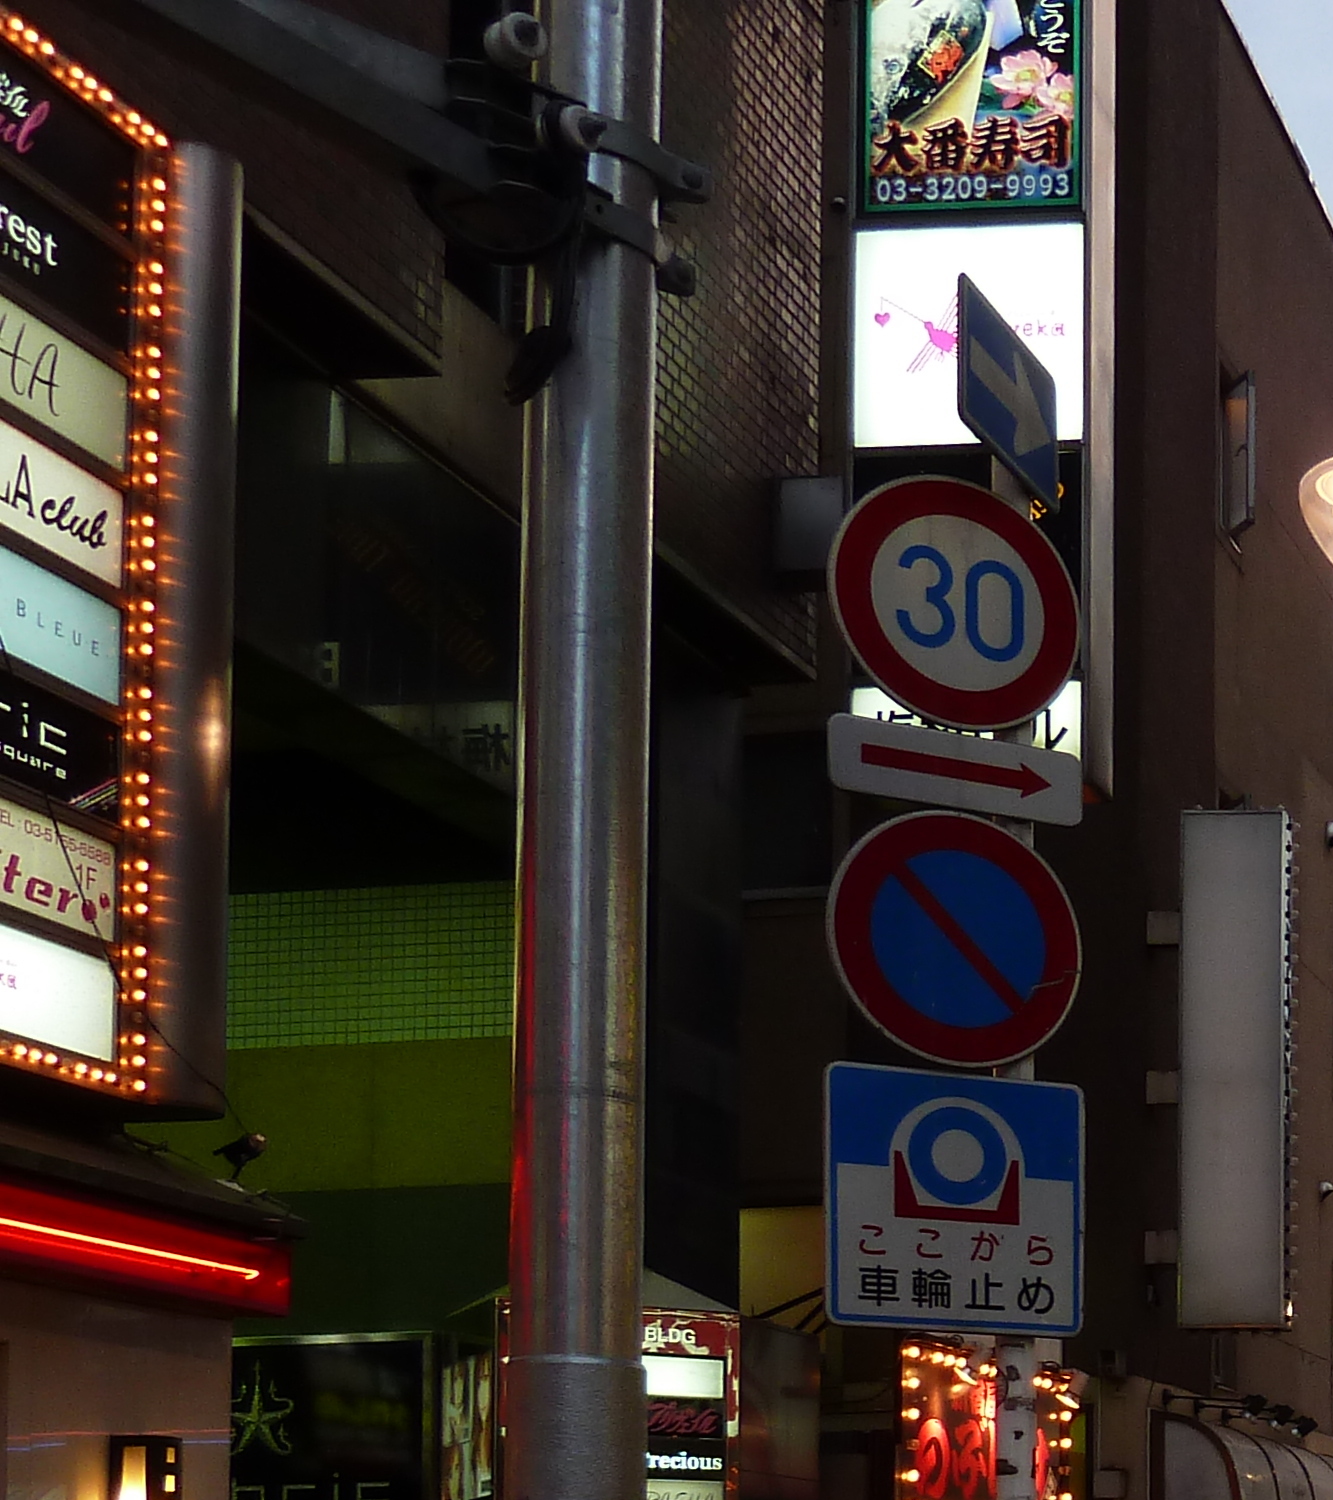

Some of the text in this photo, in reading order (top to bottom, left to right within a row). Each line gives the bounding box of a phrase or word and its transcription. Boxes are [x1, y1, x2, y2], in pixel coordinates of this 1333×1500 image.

[873, 113, 1072, 174] 大番寿司
[875, 173, 1071, 202] 03-3209-9993
[16, 596, 101, 658] BLEUE
[896, 544, 1025, 663] 30
[858, 1224, 1054, 1267] ここから
[857, 1264, 1055, 1315] 車輪止め
[644, 1327, 697, 1344] BLDG
